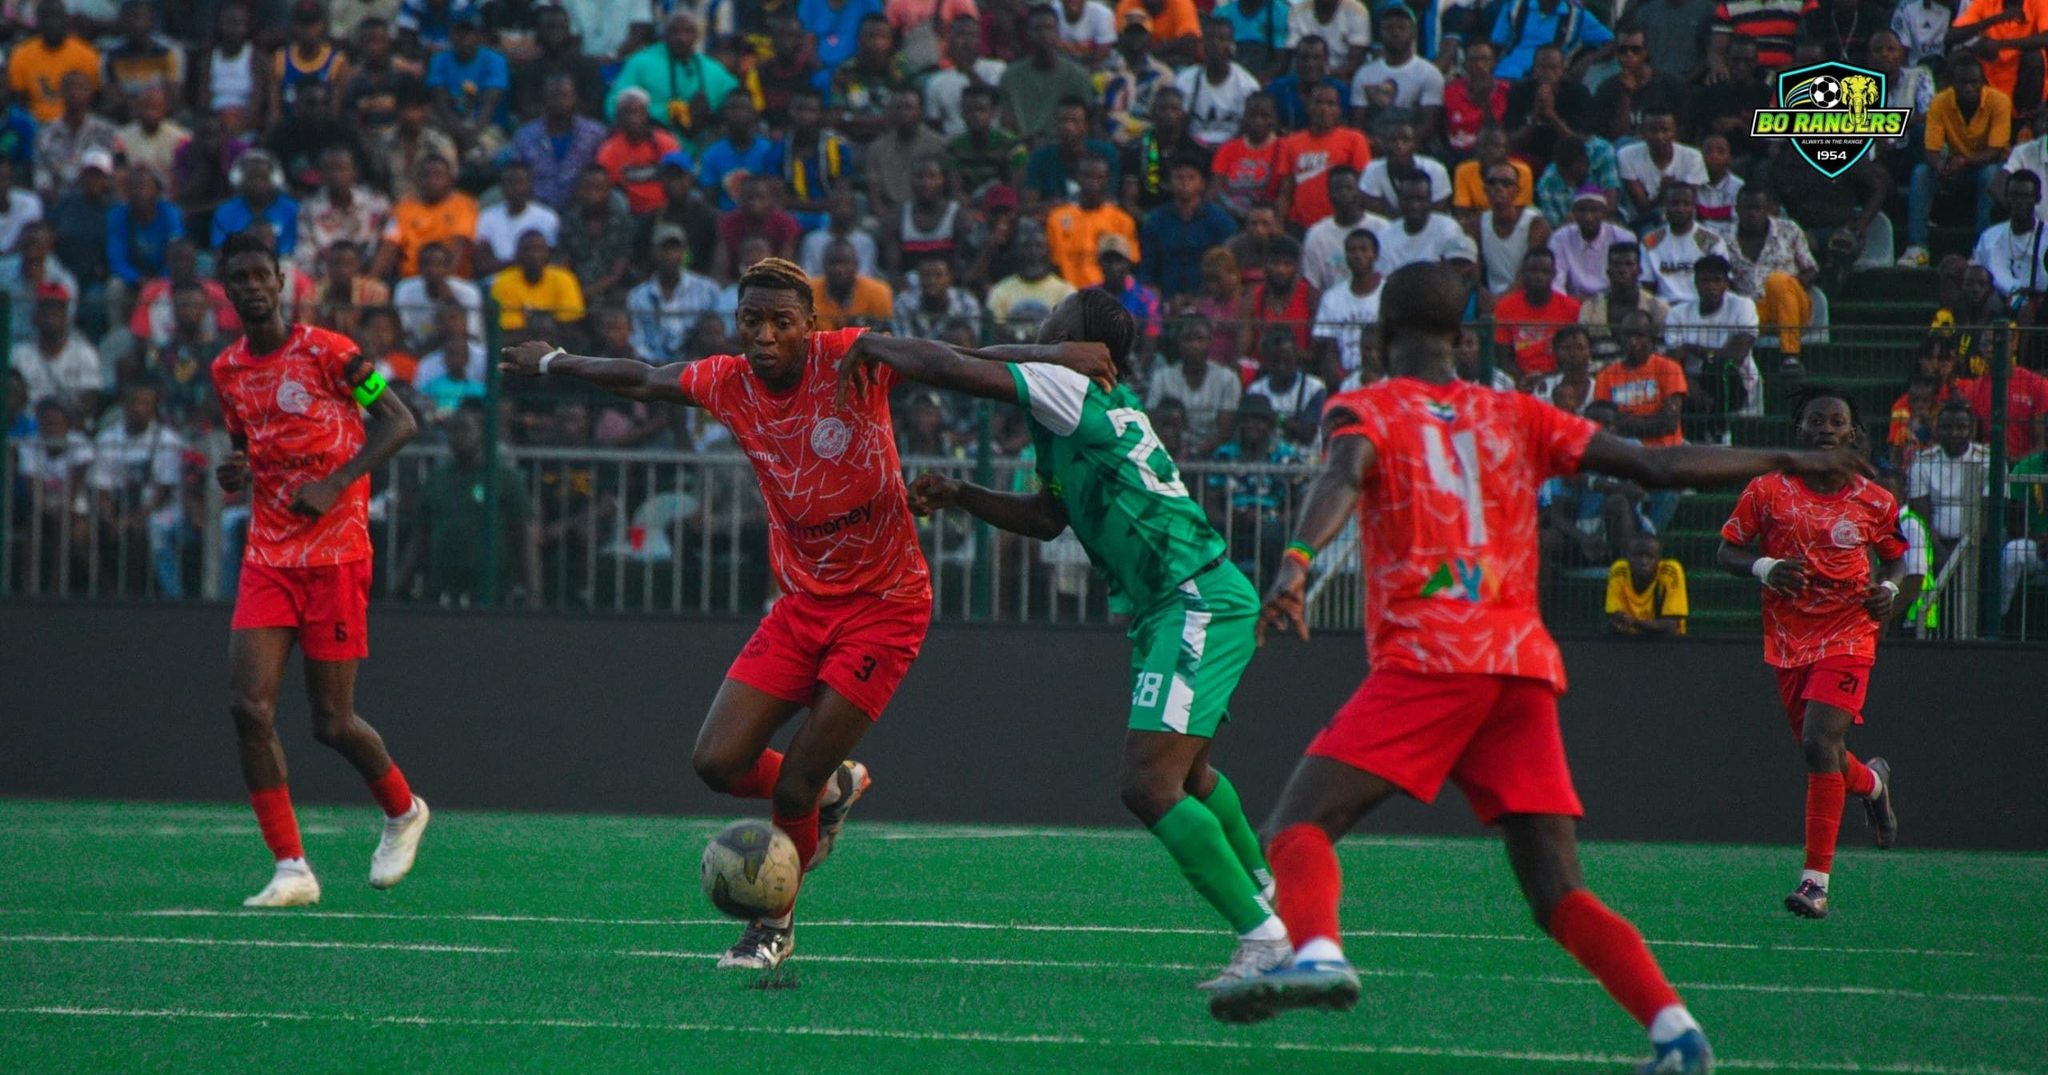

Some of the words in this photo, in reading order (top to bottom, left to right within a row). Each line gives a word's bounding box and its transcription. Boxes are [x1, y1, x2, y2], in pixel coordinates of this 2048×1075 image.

[1421, 424, 1488, 545] 4
[336, 621, 347, 643] 6
[854, 655, 877, 682] 3
[1838, 671, 1858, 695] 21
